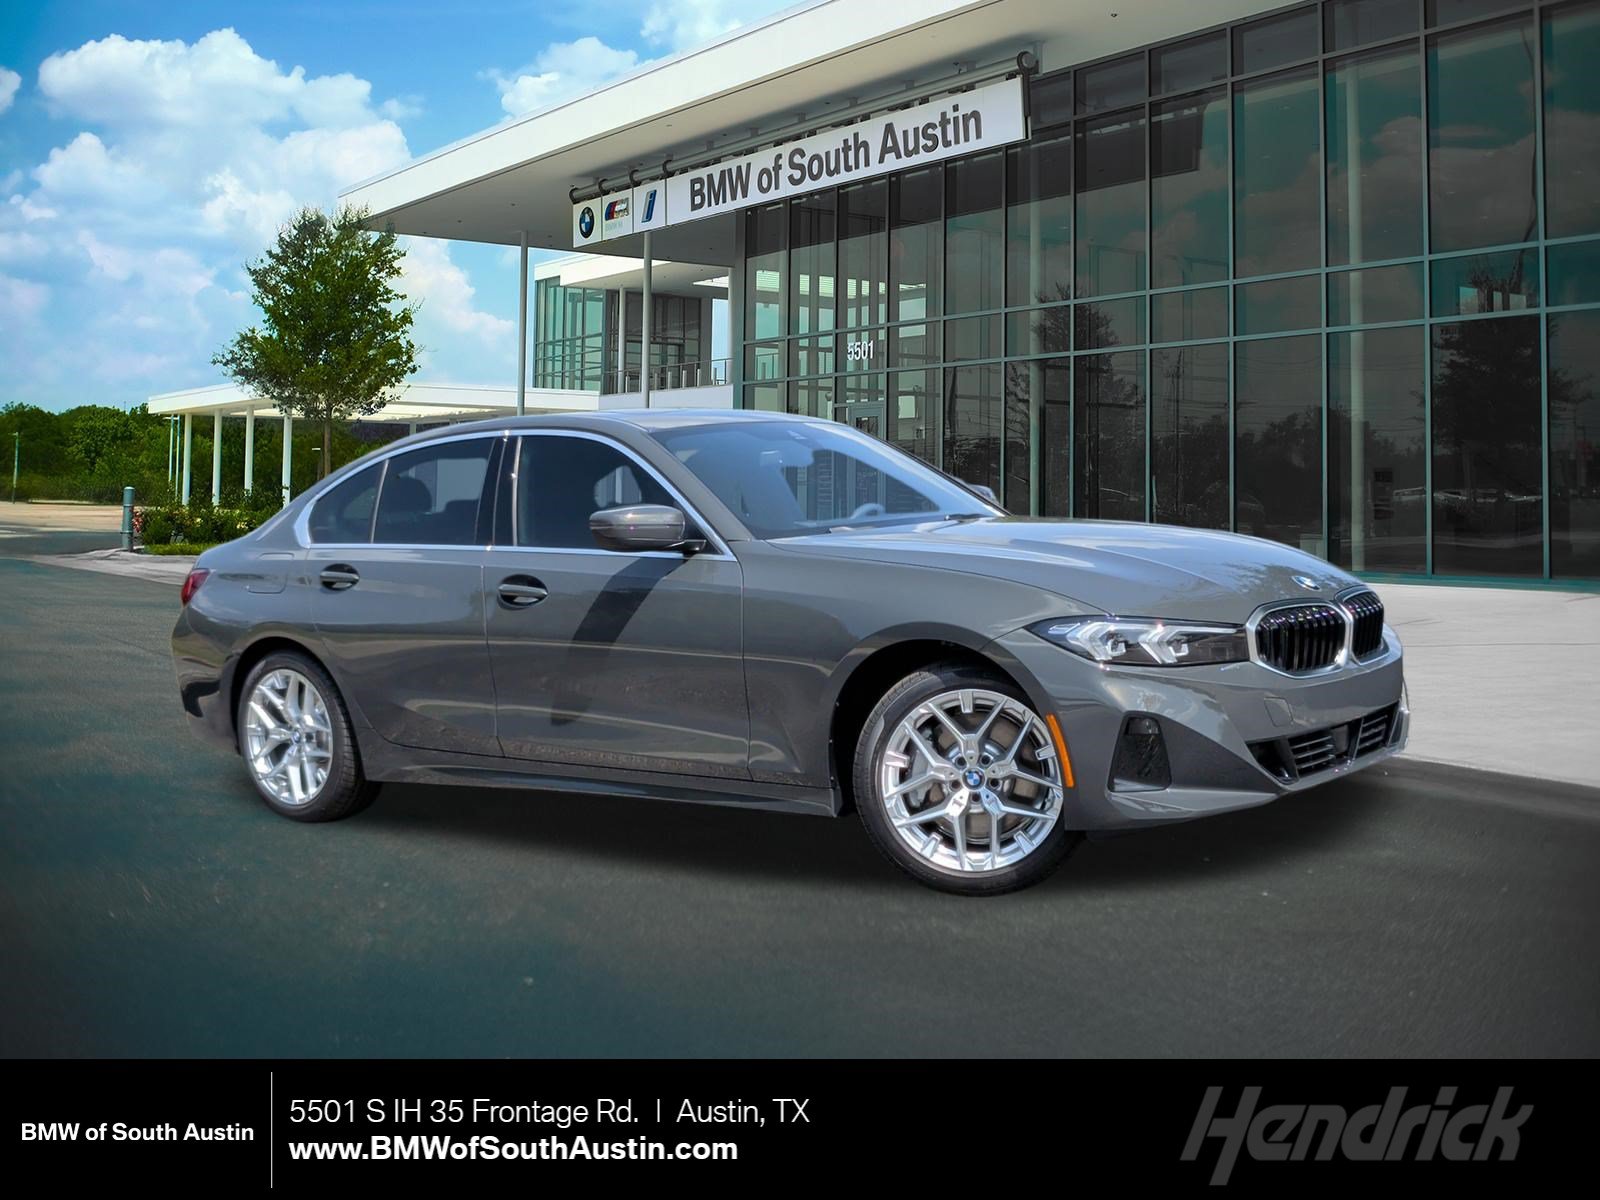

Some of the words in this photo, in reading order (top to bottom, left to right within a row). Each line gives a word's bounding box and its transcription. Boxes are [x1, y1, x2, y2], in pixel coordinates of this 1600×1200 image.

[689, 162, 752, 212] BMW
[757, 153, 783, 194] of
[787, 132, 870, 187] South
[878, 104, 983, 164] Austin
[847, 340, 874, 361] 5501
